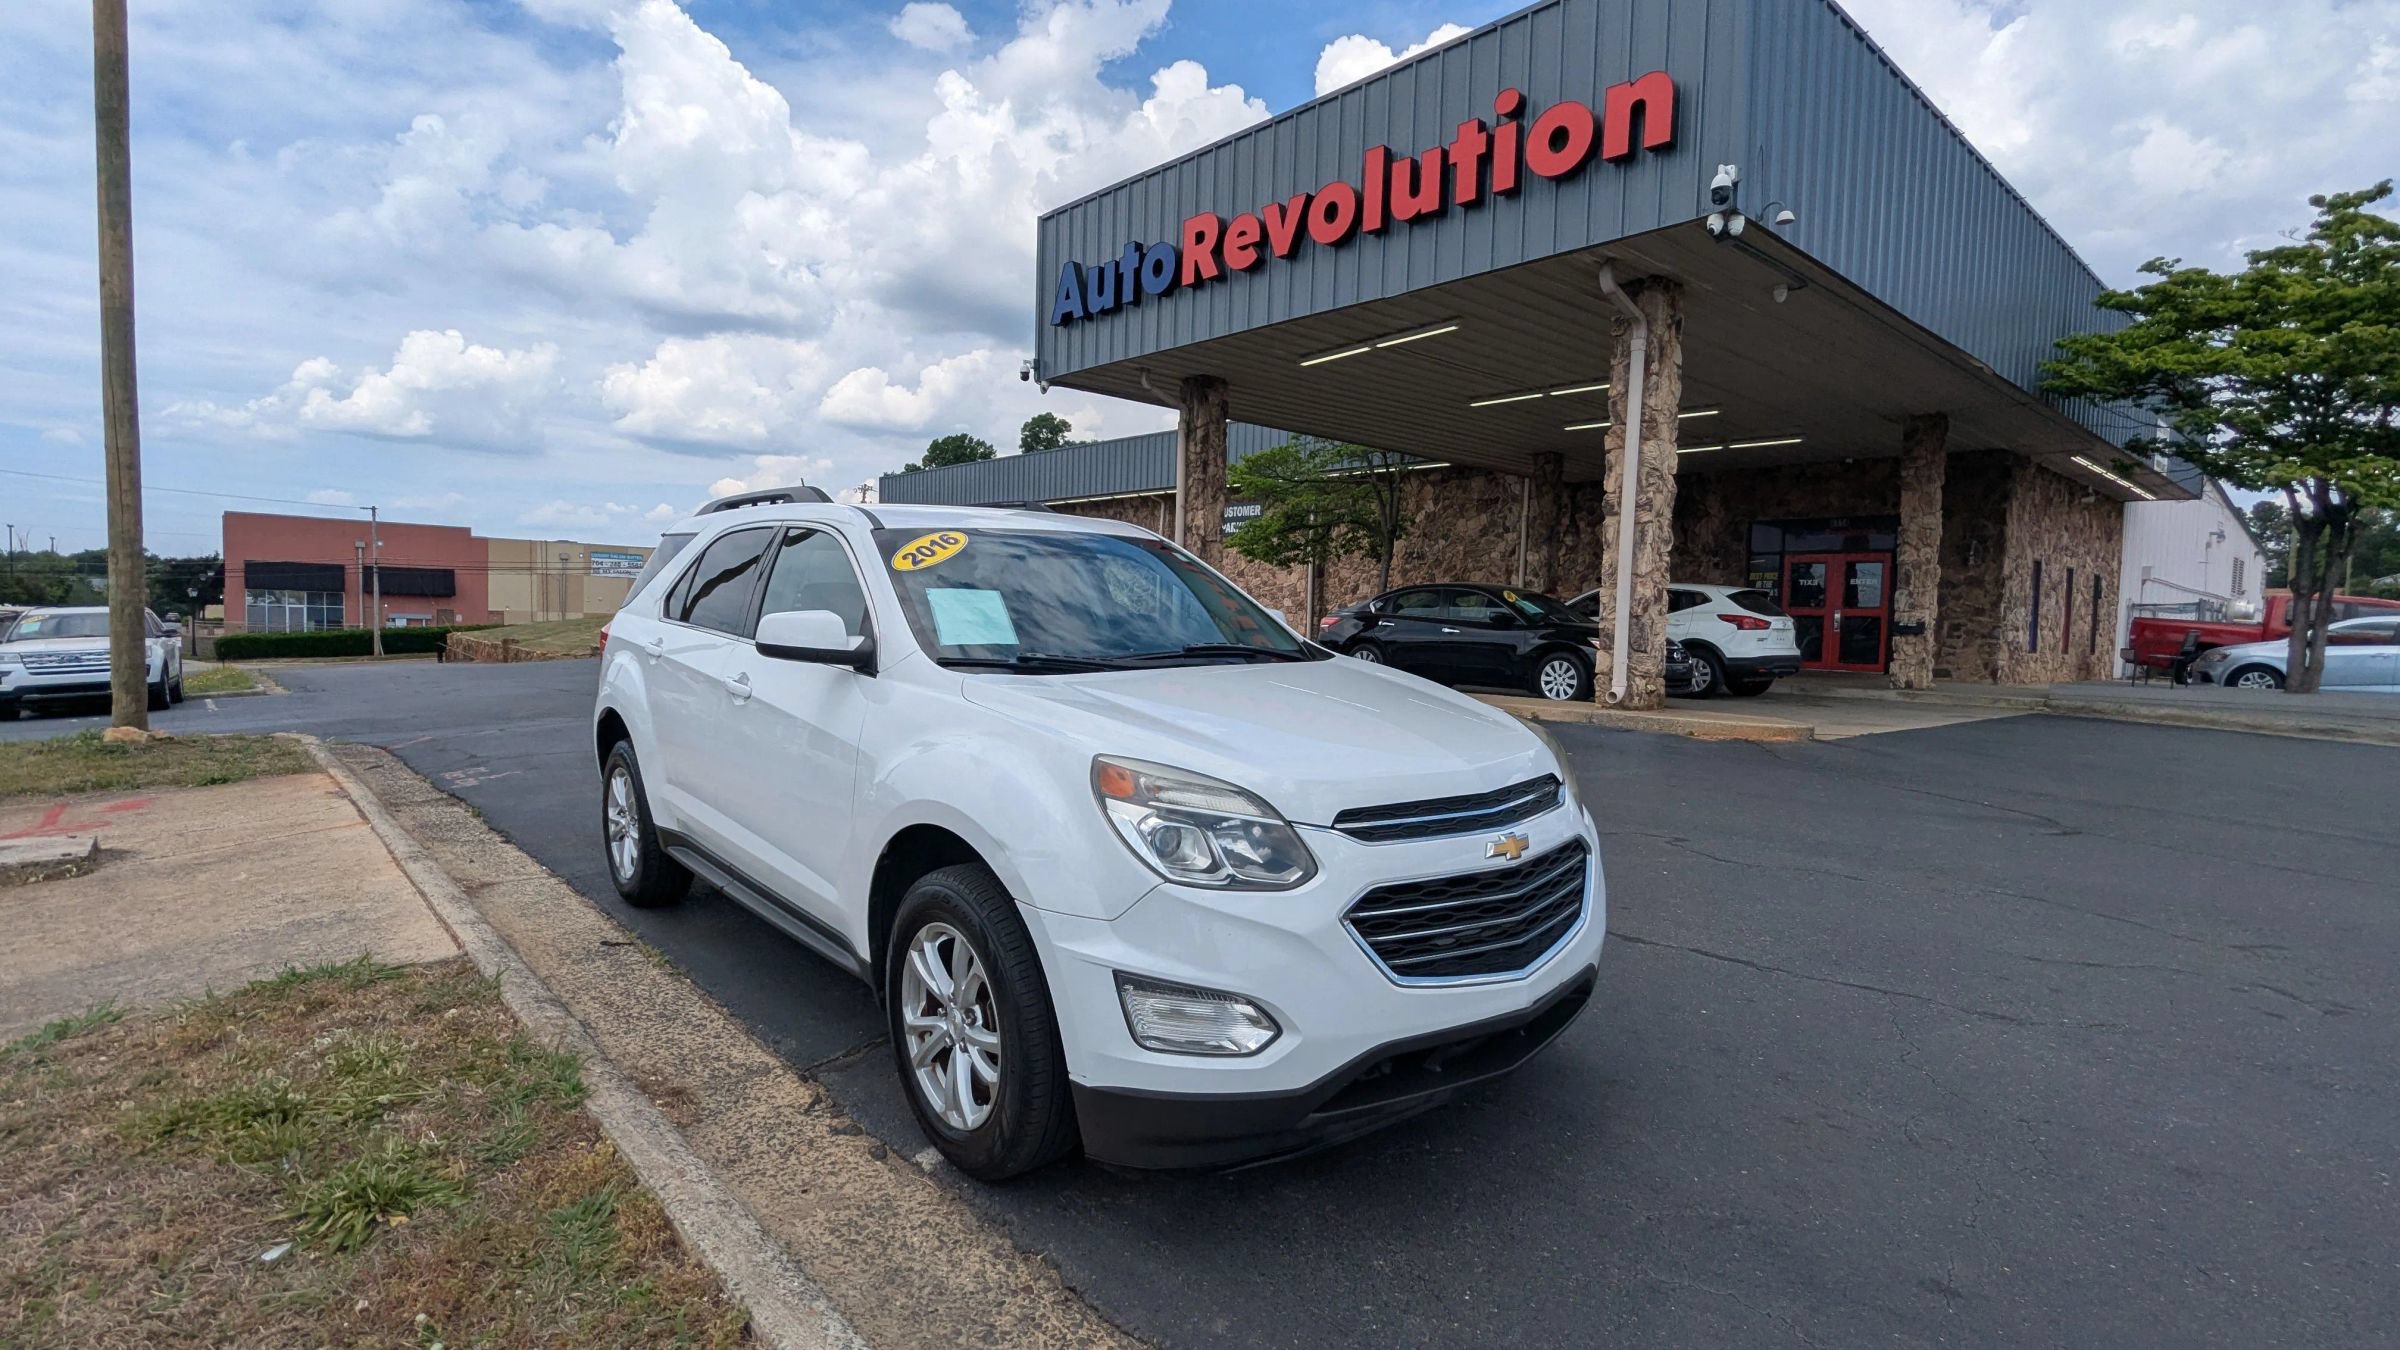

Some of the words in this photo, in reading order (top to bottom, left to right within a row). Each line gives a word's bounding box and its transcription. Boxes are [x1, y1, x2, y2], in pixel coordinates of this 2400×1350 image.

[1050, 70, 1675, 327] AutoRevolution
[1224, 505, 1261, 517] USTOMER
[902, 533, 960, 567] 2016
